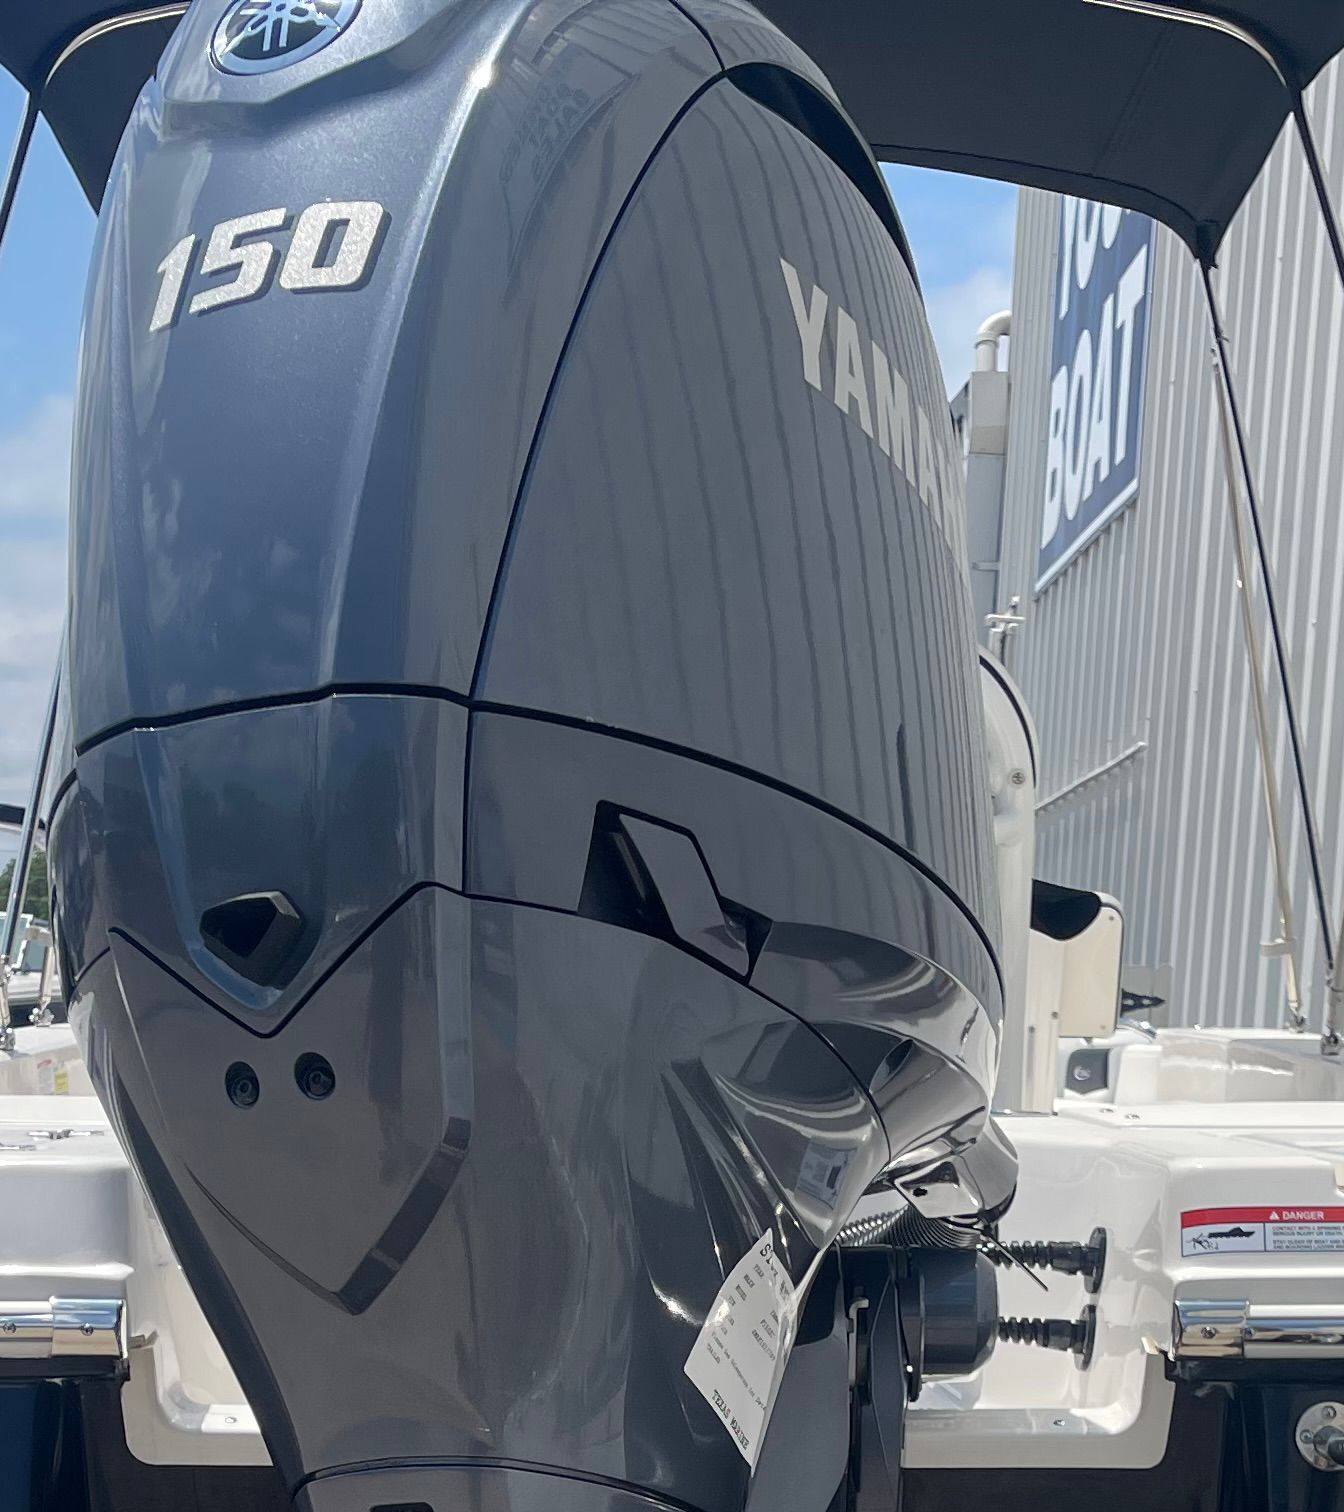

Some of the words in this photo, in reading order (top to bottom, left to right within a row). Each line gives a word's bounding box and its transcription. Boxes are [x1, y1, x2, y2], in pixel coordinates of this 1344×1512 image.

[149, 200, 391, 334] 150
[1041, 242, 1148, 549] BOAT
[1282, 1211, 1325, 1221] DANGER
[712, 1389, 732, 1419] TEXAS
